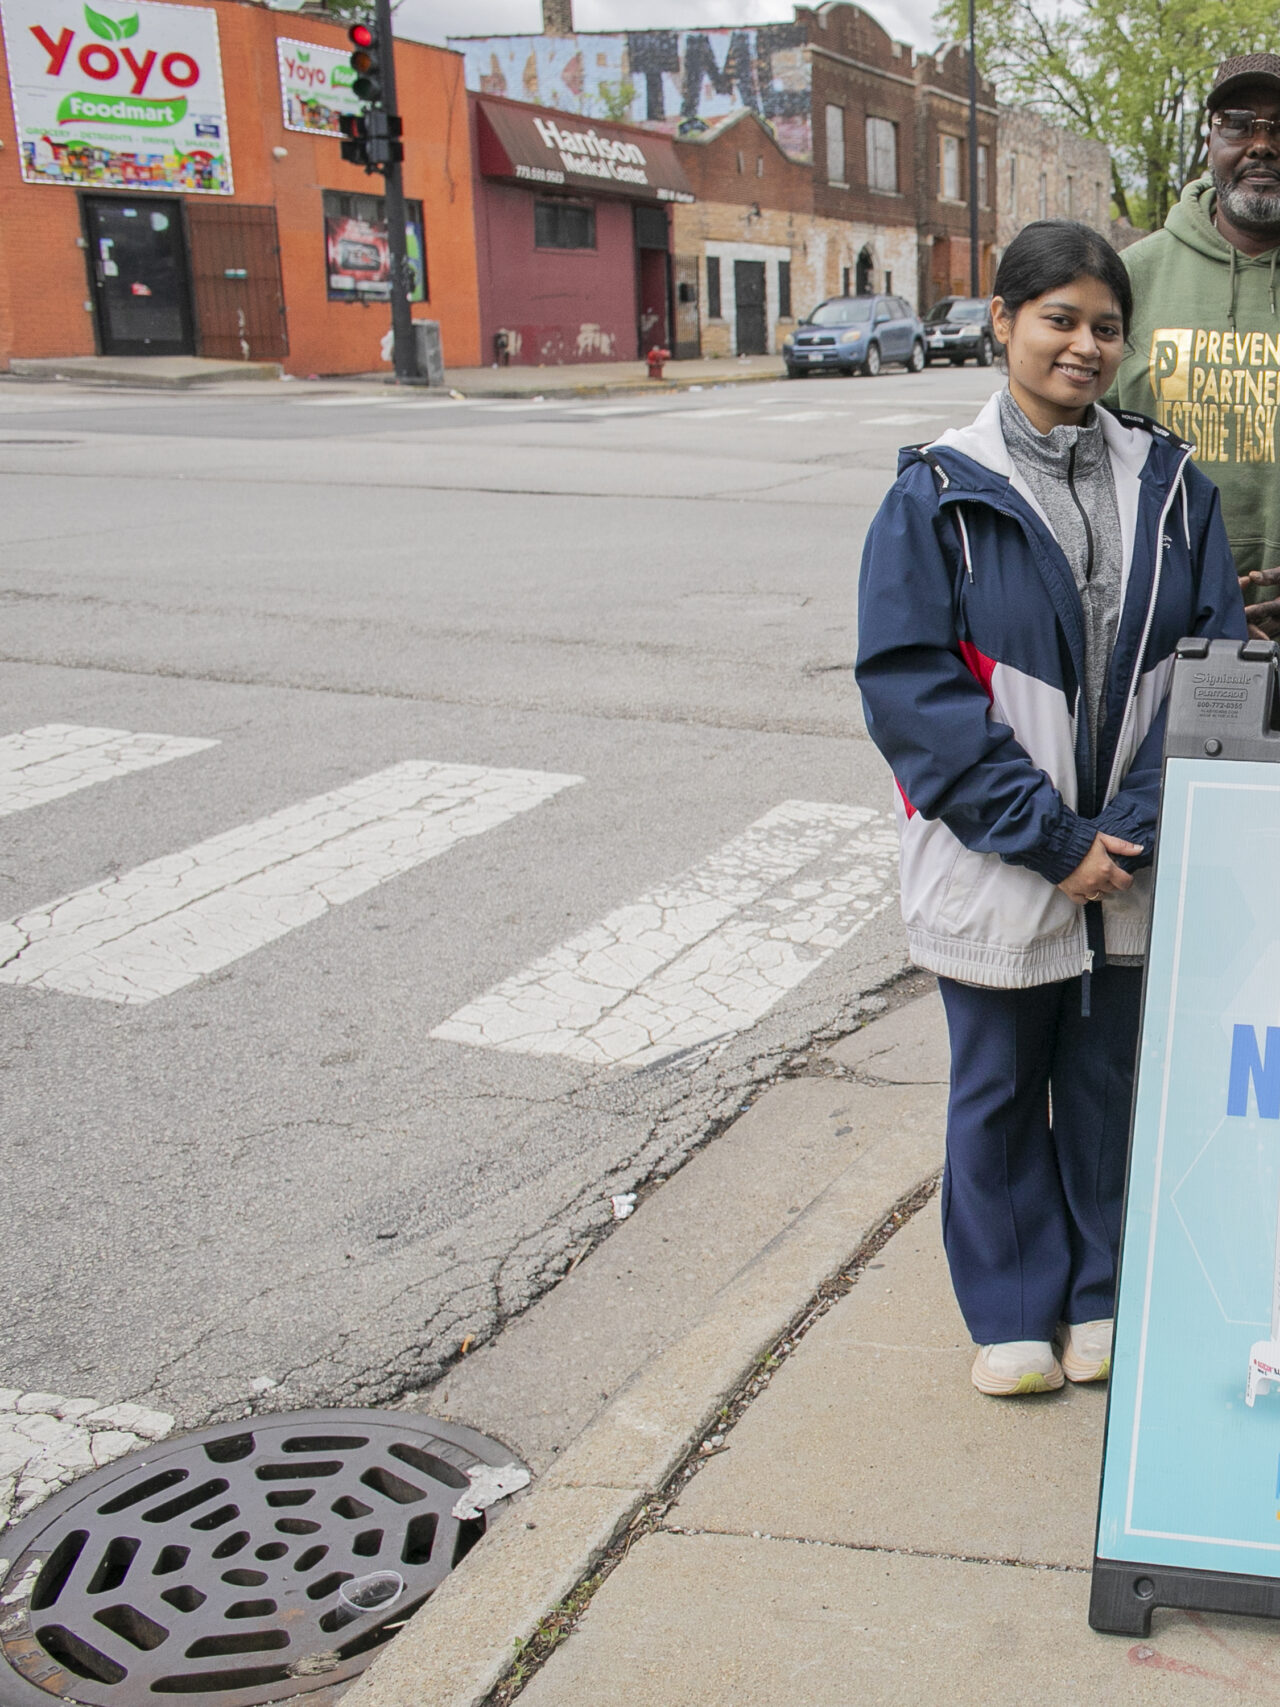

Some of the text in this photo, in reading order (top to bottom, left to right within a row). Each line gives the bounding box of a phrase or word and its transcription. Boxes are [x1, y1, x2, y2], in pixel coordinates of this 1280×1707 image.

[28, 25, 200, 95] Yoyo
[284, 56, 326, 88] Yoyo
[69, 96, 175, 123] Foodmart
[533, 117, 647, 166] Harrison
[559, 151, 648, 185] Medical Center
[1233, 404, 1278, 464] TASK
